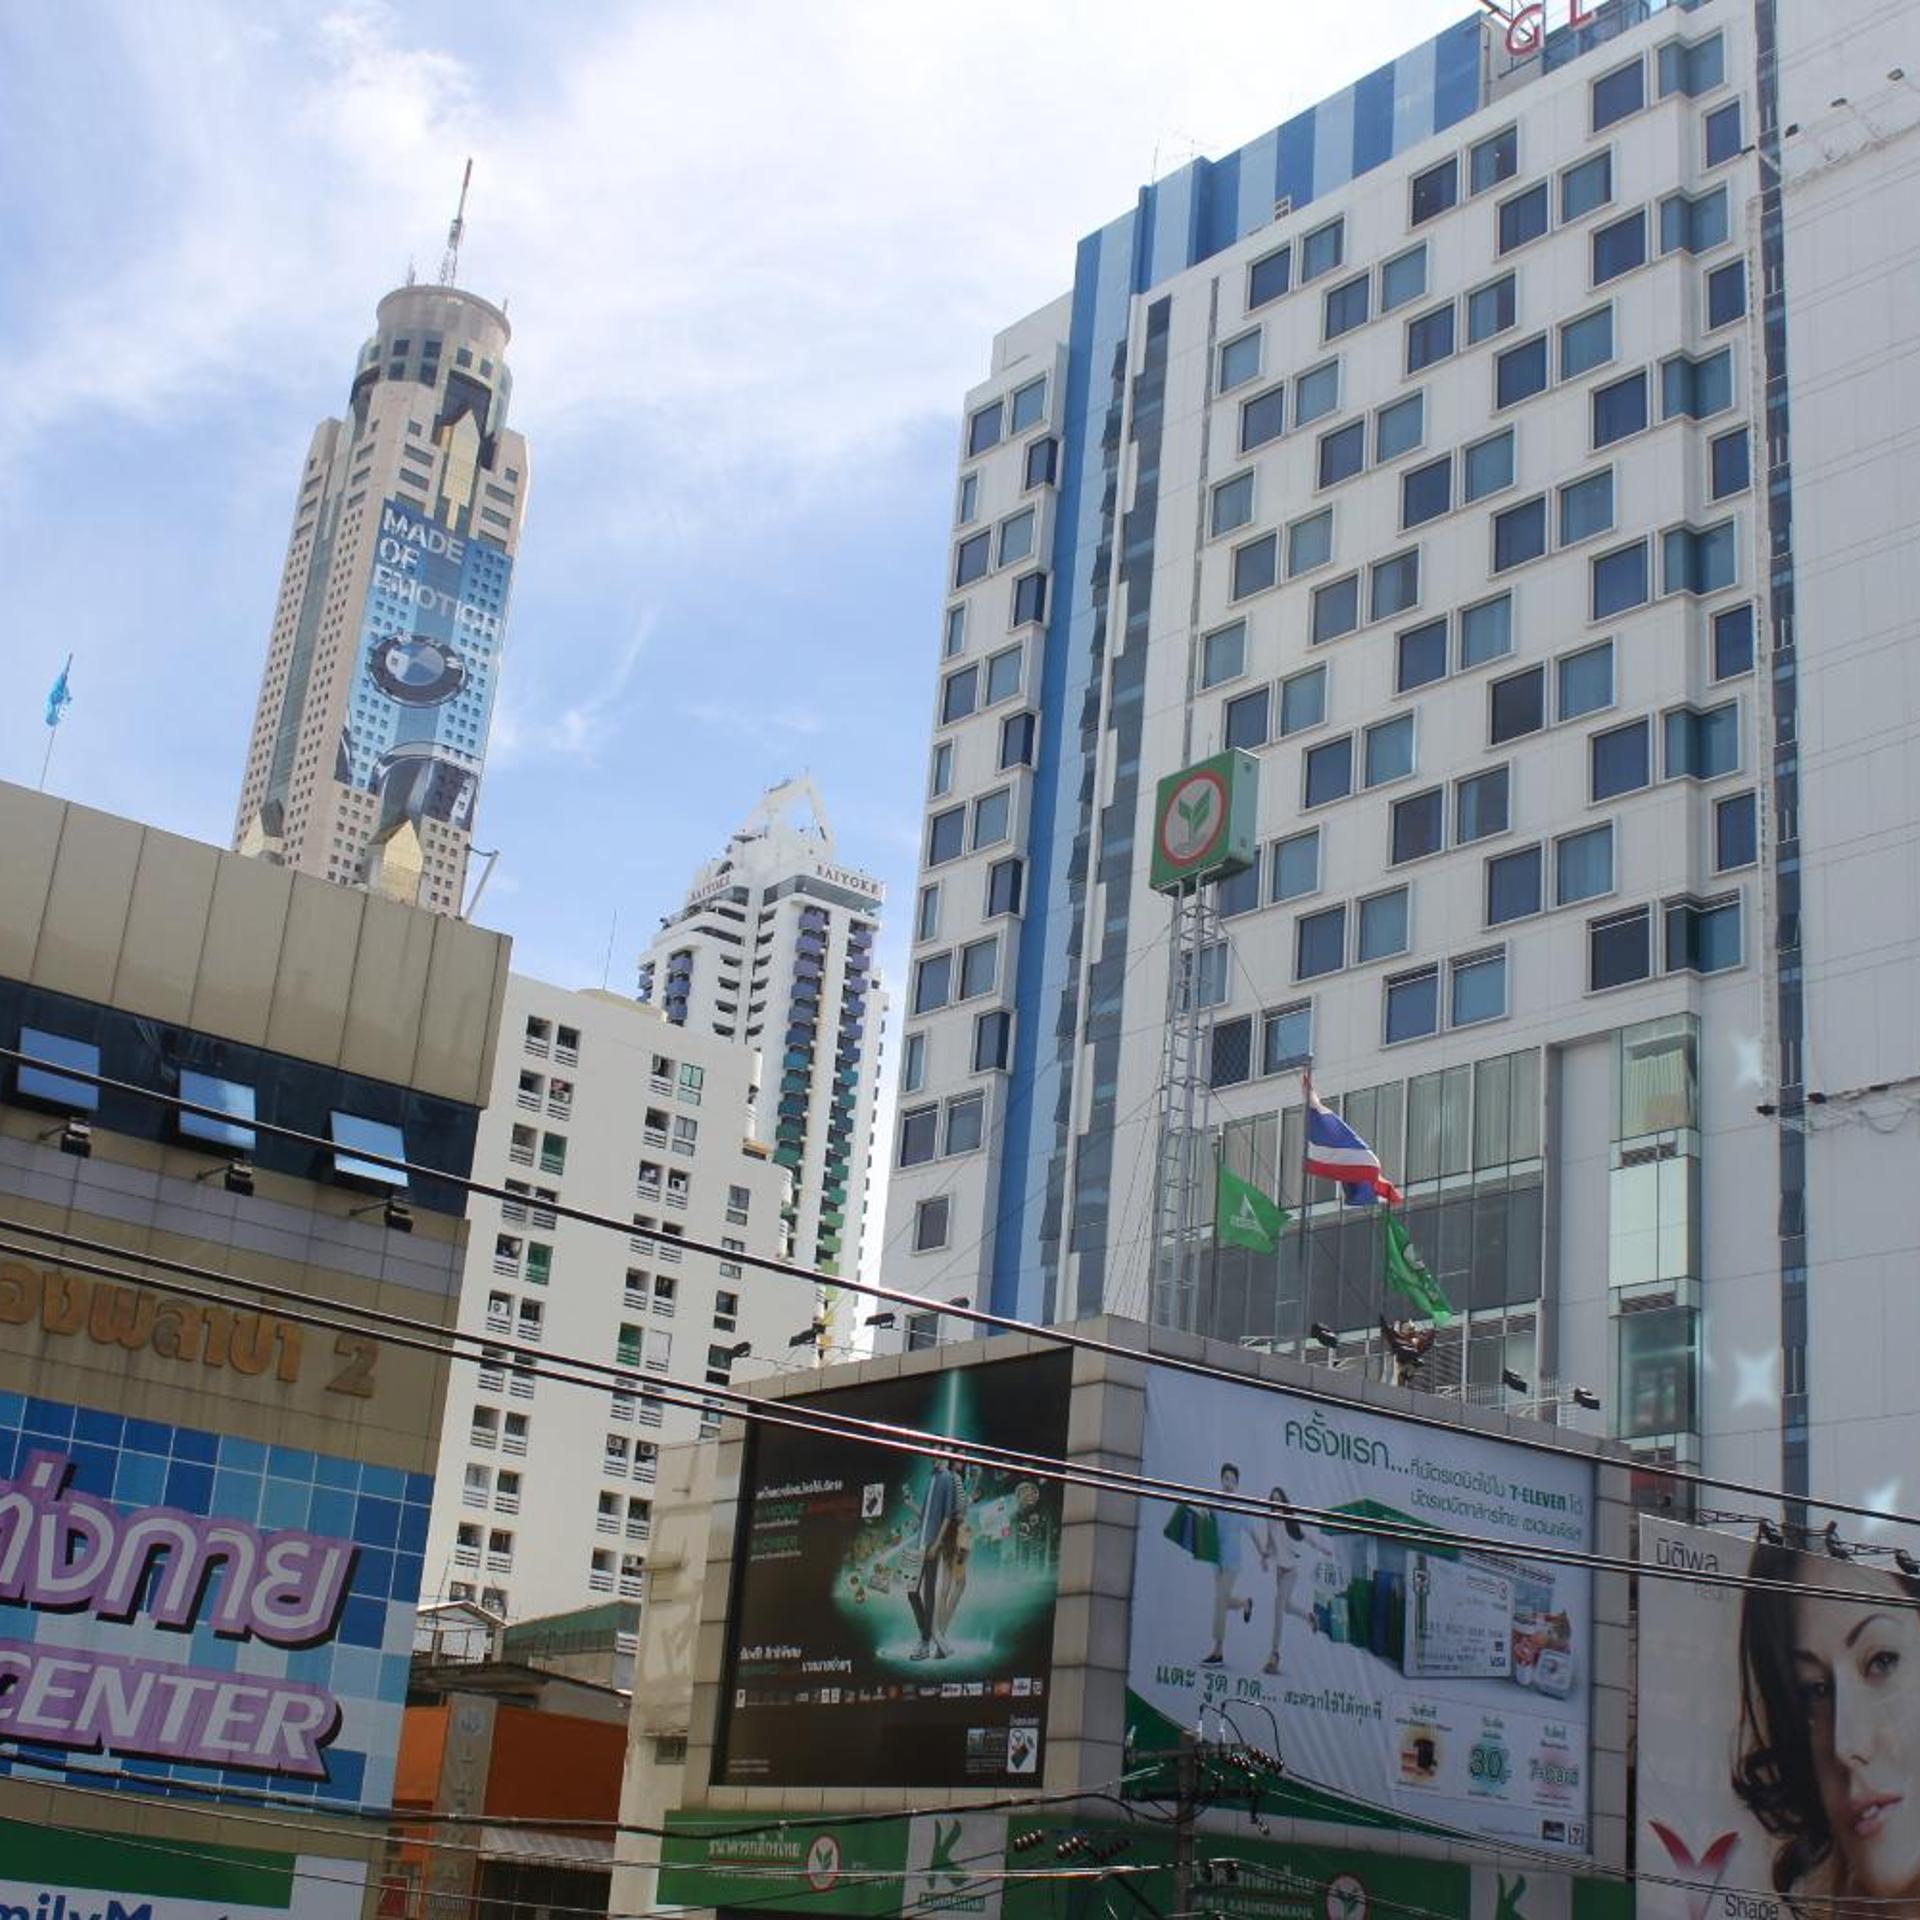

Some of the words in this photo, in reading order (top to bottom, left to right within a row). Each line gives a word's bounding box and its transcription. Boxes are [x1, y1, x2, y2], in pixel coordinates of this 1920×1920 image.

[382, 508, 466, 565] MADE
[379, 538, 420, 570] OF
[1724, 1892, 1780, 1920] Shape
